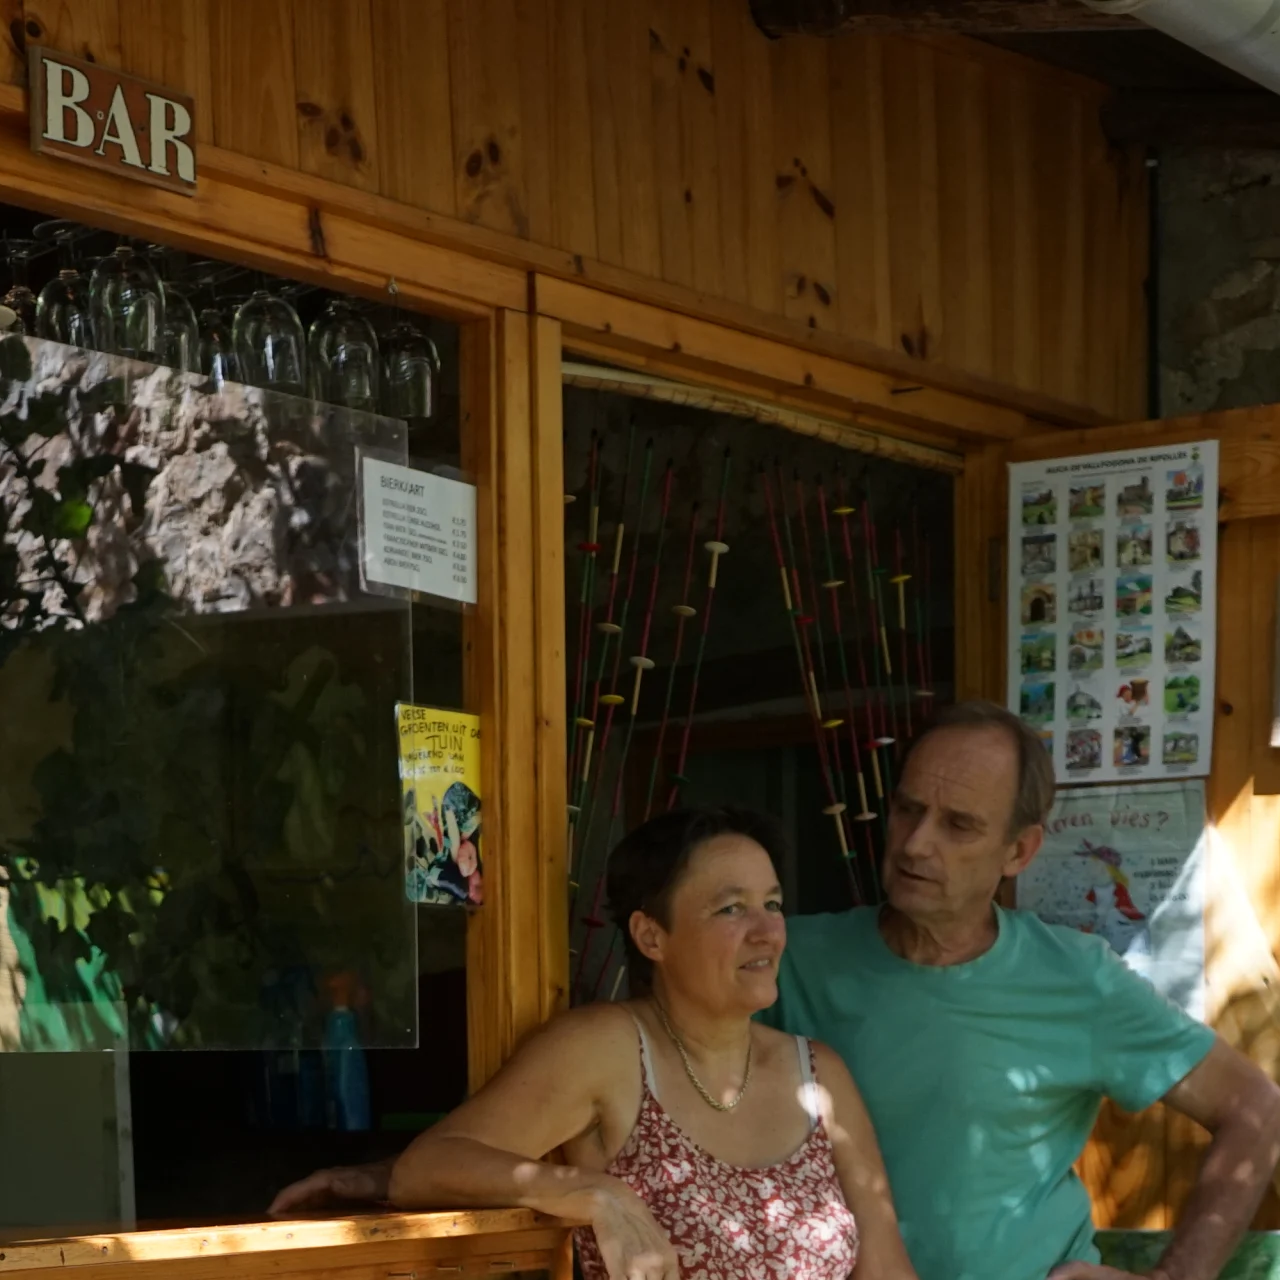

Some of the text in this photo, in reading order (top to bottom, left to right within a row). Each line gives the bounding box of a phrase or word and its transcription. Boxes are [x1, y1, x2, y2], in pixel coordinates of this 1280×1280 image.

[42, 58, 195, 184] BAR
[425, 734, 463, 751] TUIN
[1109, 805, 1169, 832] vies?
